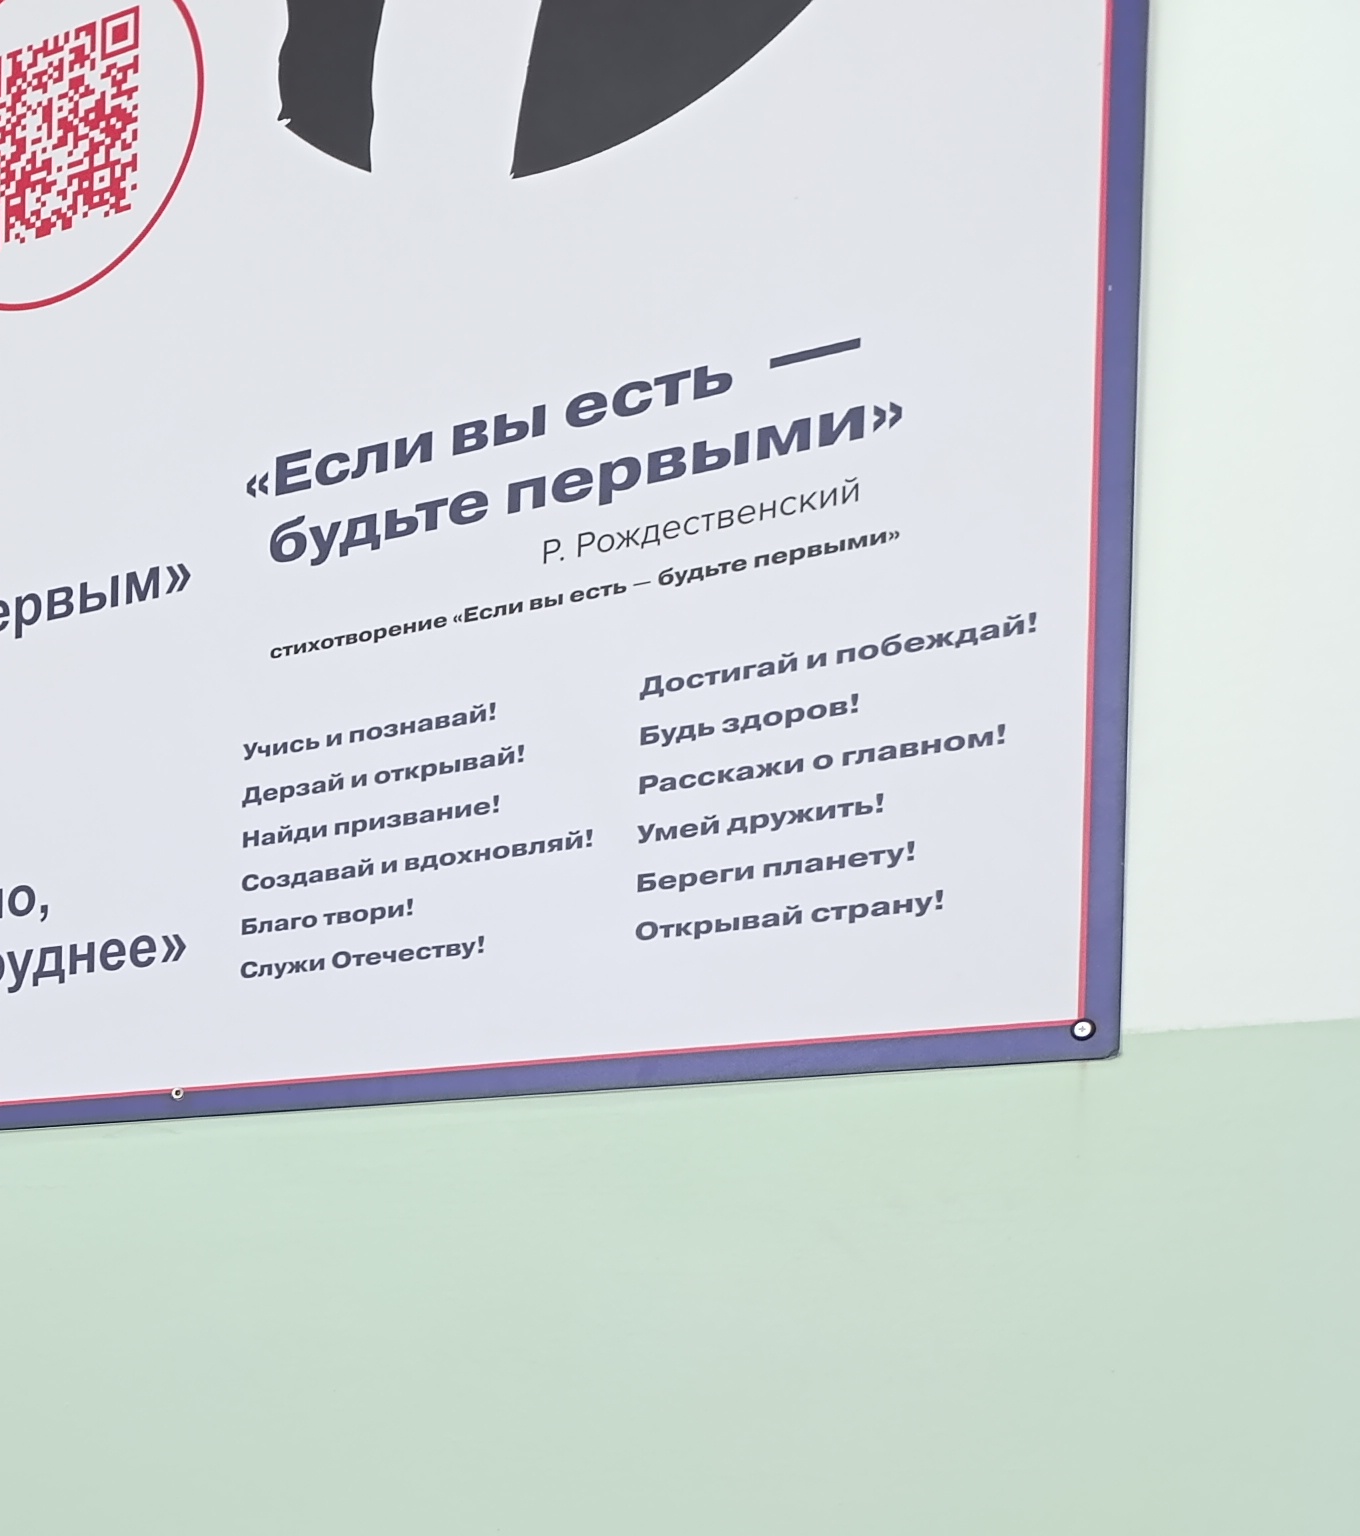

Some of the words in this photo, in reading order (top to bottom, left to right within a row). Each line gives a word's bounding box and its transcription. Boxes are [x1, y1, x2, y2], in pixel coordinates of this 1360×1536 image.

[246, 431, 433, 498] «Если
[452, 404, 546, 456] вы
[565, 365, 733, 428] есть
[270, 490, 489, 566] будьте
[507, 402, 902, 514] первыми»
[543, 538, 564, 564] Р.
[577, 477, 859, 558] Рождественский
[270, 616, 448, 659] стихотворение
[453, 601, 524, 623] «Если
[530, 593, 564, 611] вы
[570, 582, 627, 603] есть
[658, 558, 747, 587] будьте
[754, 530, 900, 568] первыми»
[639, 652, 798, 701] Достигай
[806, 652, 827, 670] и
[836, 612, 1037, 664] побеждай!
[243, 738, 320, 761] Учись
[326, 732, 342, 747] и
[349, 702, 496, 744] познавай!
[640, 722, 715, 748] Будь
[722, 693, 859, 734] здоров!
[242, 772, 344, 808] Дерзай
[351, 773, 367, 788] и
[374, 744, 524, 784] открывай!
[639, 758, 804, 795] Расскажи
[812, 754, 834, 770] о
[842, 724, 1006, 766] главном!
[242, 824, 328, 848] Найди
[334, 794, 500, 838] призвание!
[637, 814, 720, 844] Умей
[726, 792, 884, 836] дружить!
[242, 858, 374, 892] Создавай
[381, 860, 398, 874] и
[404, 828, 593, 872] вдохновляй!
[637, 865, 754, 893] Береги
[763, 840, 915, 878] планету!
[241, 914, 318, 936] Благо
[322, 898, 413, 926] твори!
[635, 904, 802, 941] Открывай
[811, 889, 944, 924] страну!
[240, 958, 325, 980] Служи
[332, 935, 484, 969] Отечеству!
